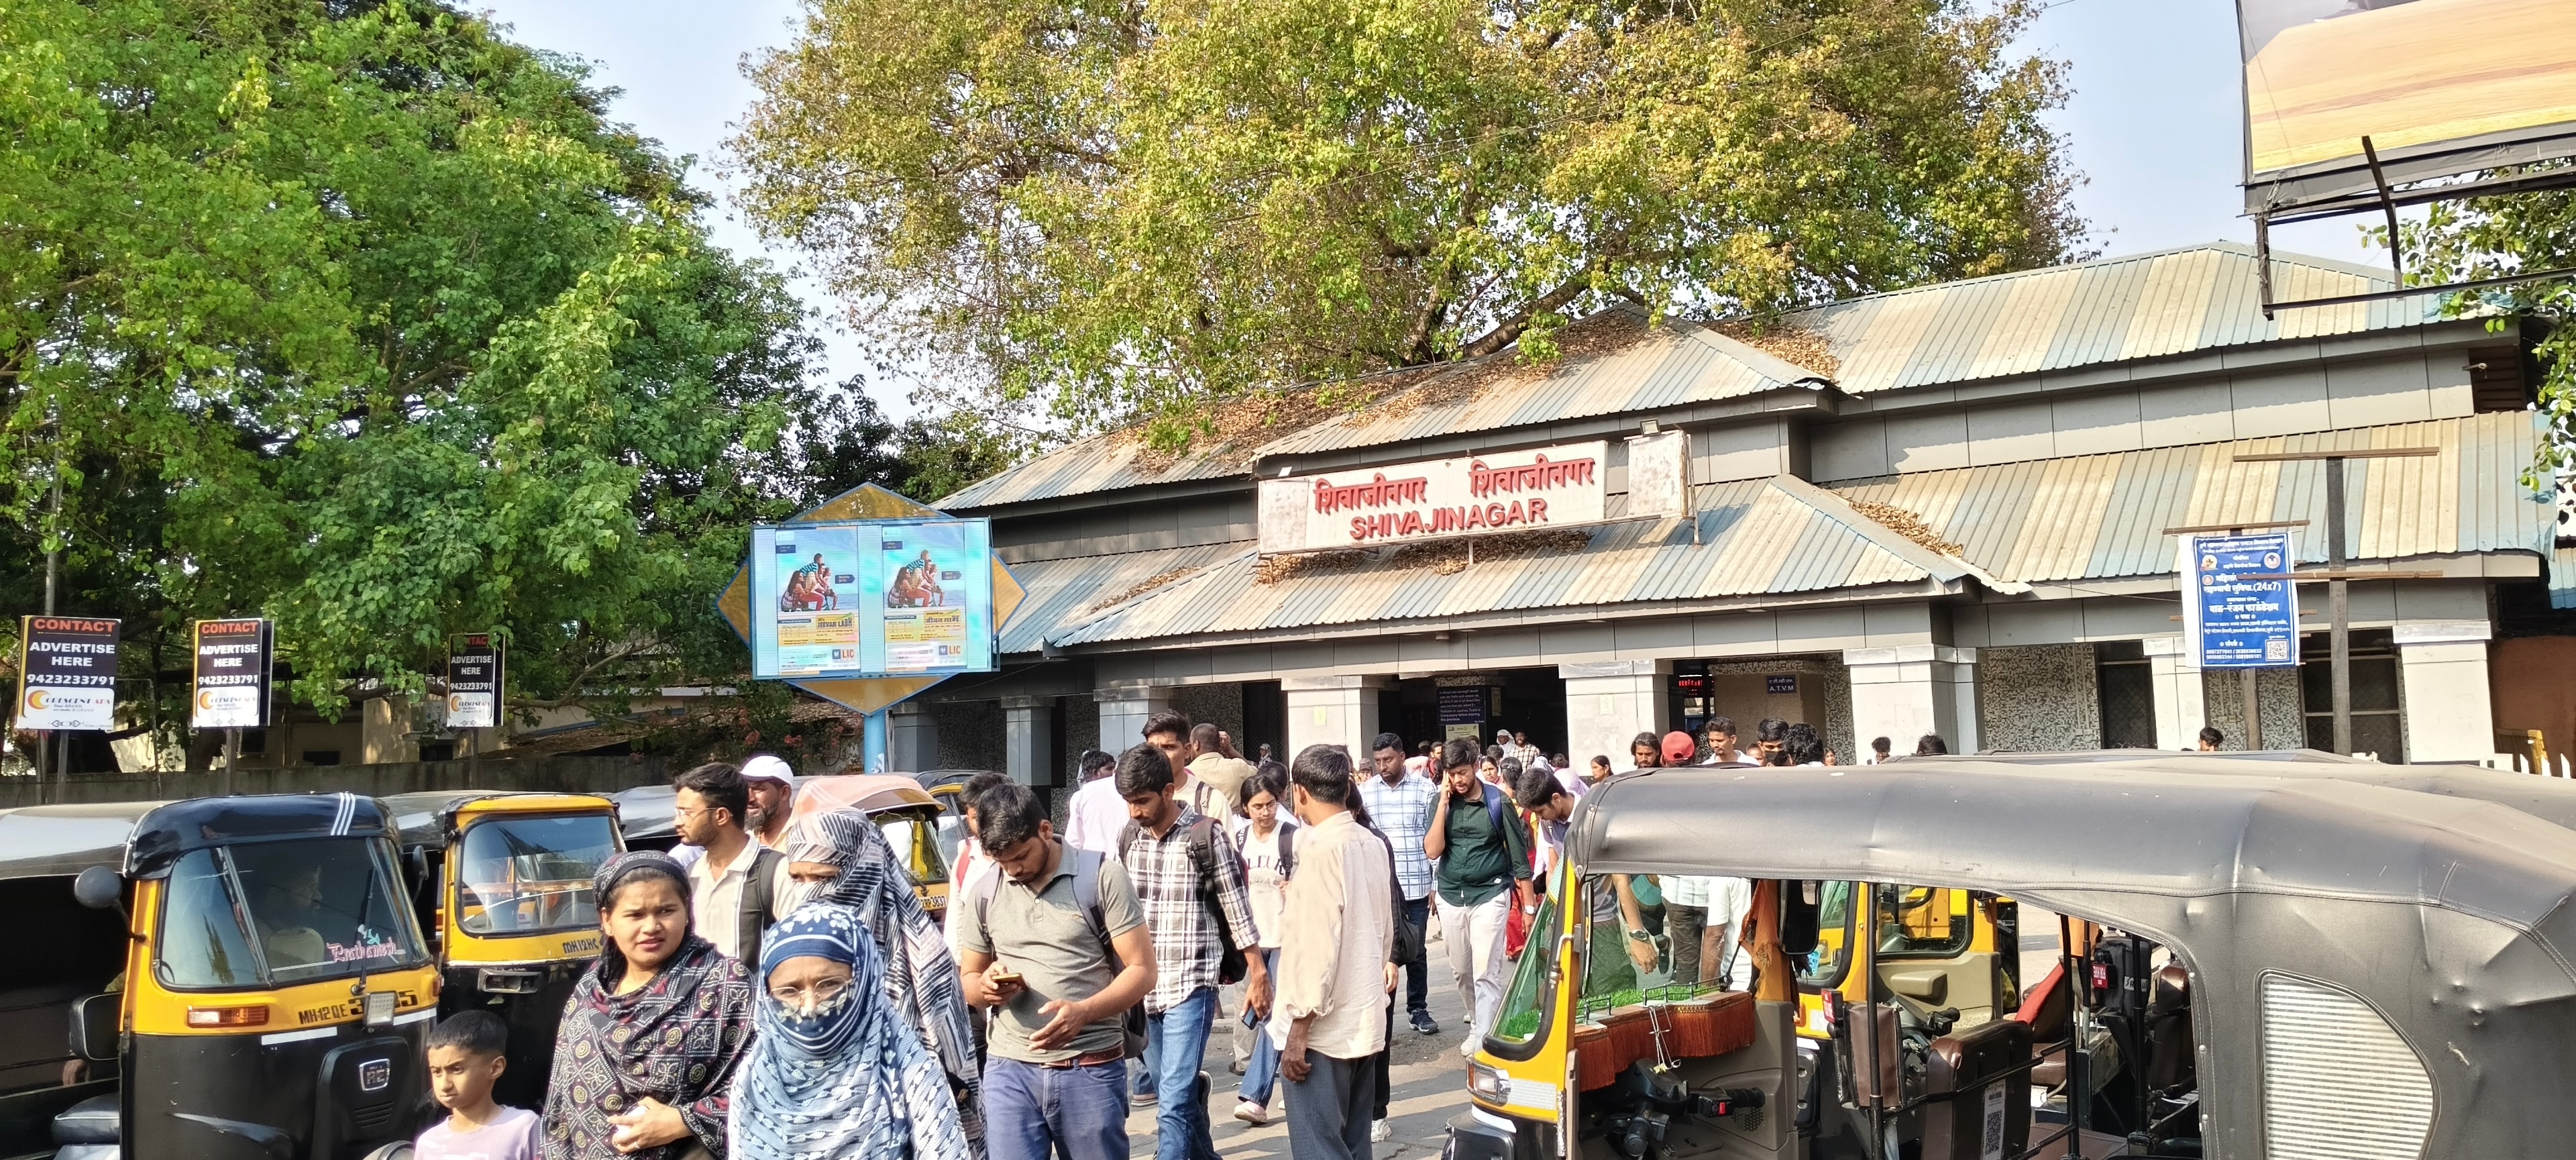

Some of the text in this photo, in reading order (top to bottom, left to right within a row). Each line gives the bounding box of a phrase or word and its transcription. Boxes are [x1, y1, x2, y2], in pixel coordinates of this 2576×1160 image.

[1313, 453, 1595, 515] शिवाजीनगर शिवाजीनगर
[1349, 498, 1548, 539] SHIVAJINAGAR
[34, 619, 116, 632] CONTACT
[201, 622, 258, 634] CONTACT
[838, 618, 853, 627] LABH
[30, 641, 115, 654] ADVERTISE
[199, 644, 258, 655] ADVERTISE
[949, 645, 961, 654] LIC
[842, 649, 855, 658] LIC
[52, 656, 93, 667] HERE
[213, 657, 243, 668] HERE
[451, 655, 492, 664] ADVERTISE
[461, 667, 481, 675] HERE
[27, 674, 115, 685] 9423233791
[198, 674, 258, 685] 9423233791
[450, 682, 492, 690] 9423233791
